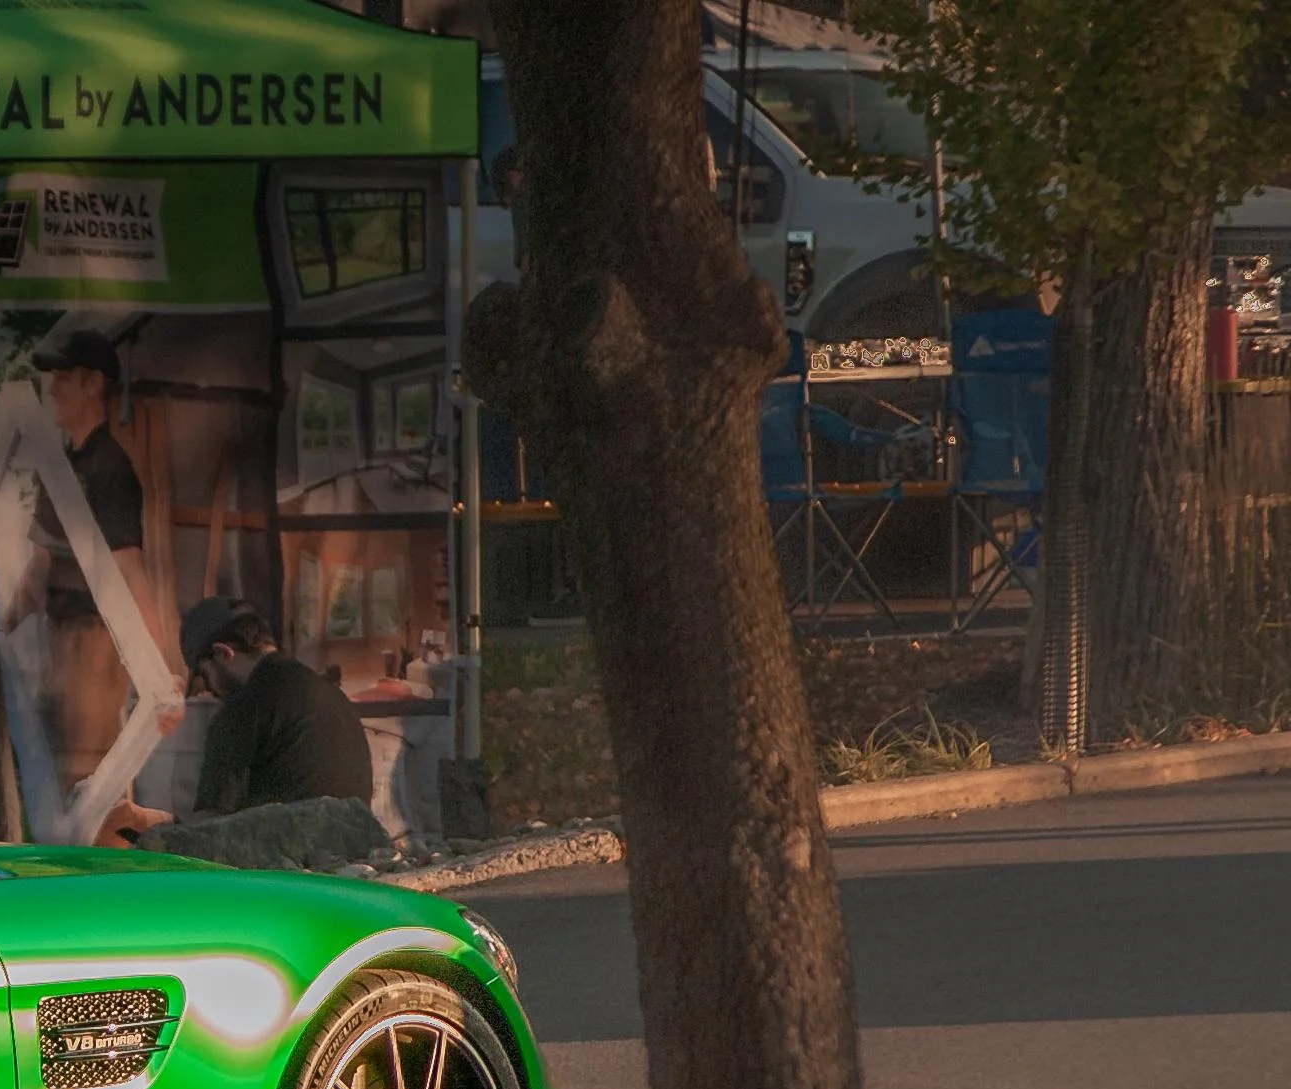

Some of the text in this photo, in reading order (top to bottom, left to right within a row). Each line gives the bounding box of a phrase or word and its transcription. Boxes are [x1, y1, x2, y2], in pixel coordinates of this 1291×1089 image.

[75, 75, 112, 128] by
[122, 73, 382, 127] ANDERSEN
[44, 188, 151, 217] RENEWAL
[44, 218, 156, 240] by ANDERSEN
[65, 1033, 142, 1051] V8 BITURBO
[318, 1012, 363, 1076] MICHELIN
